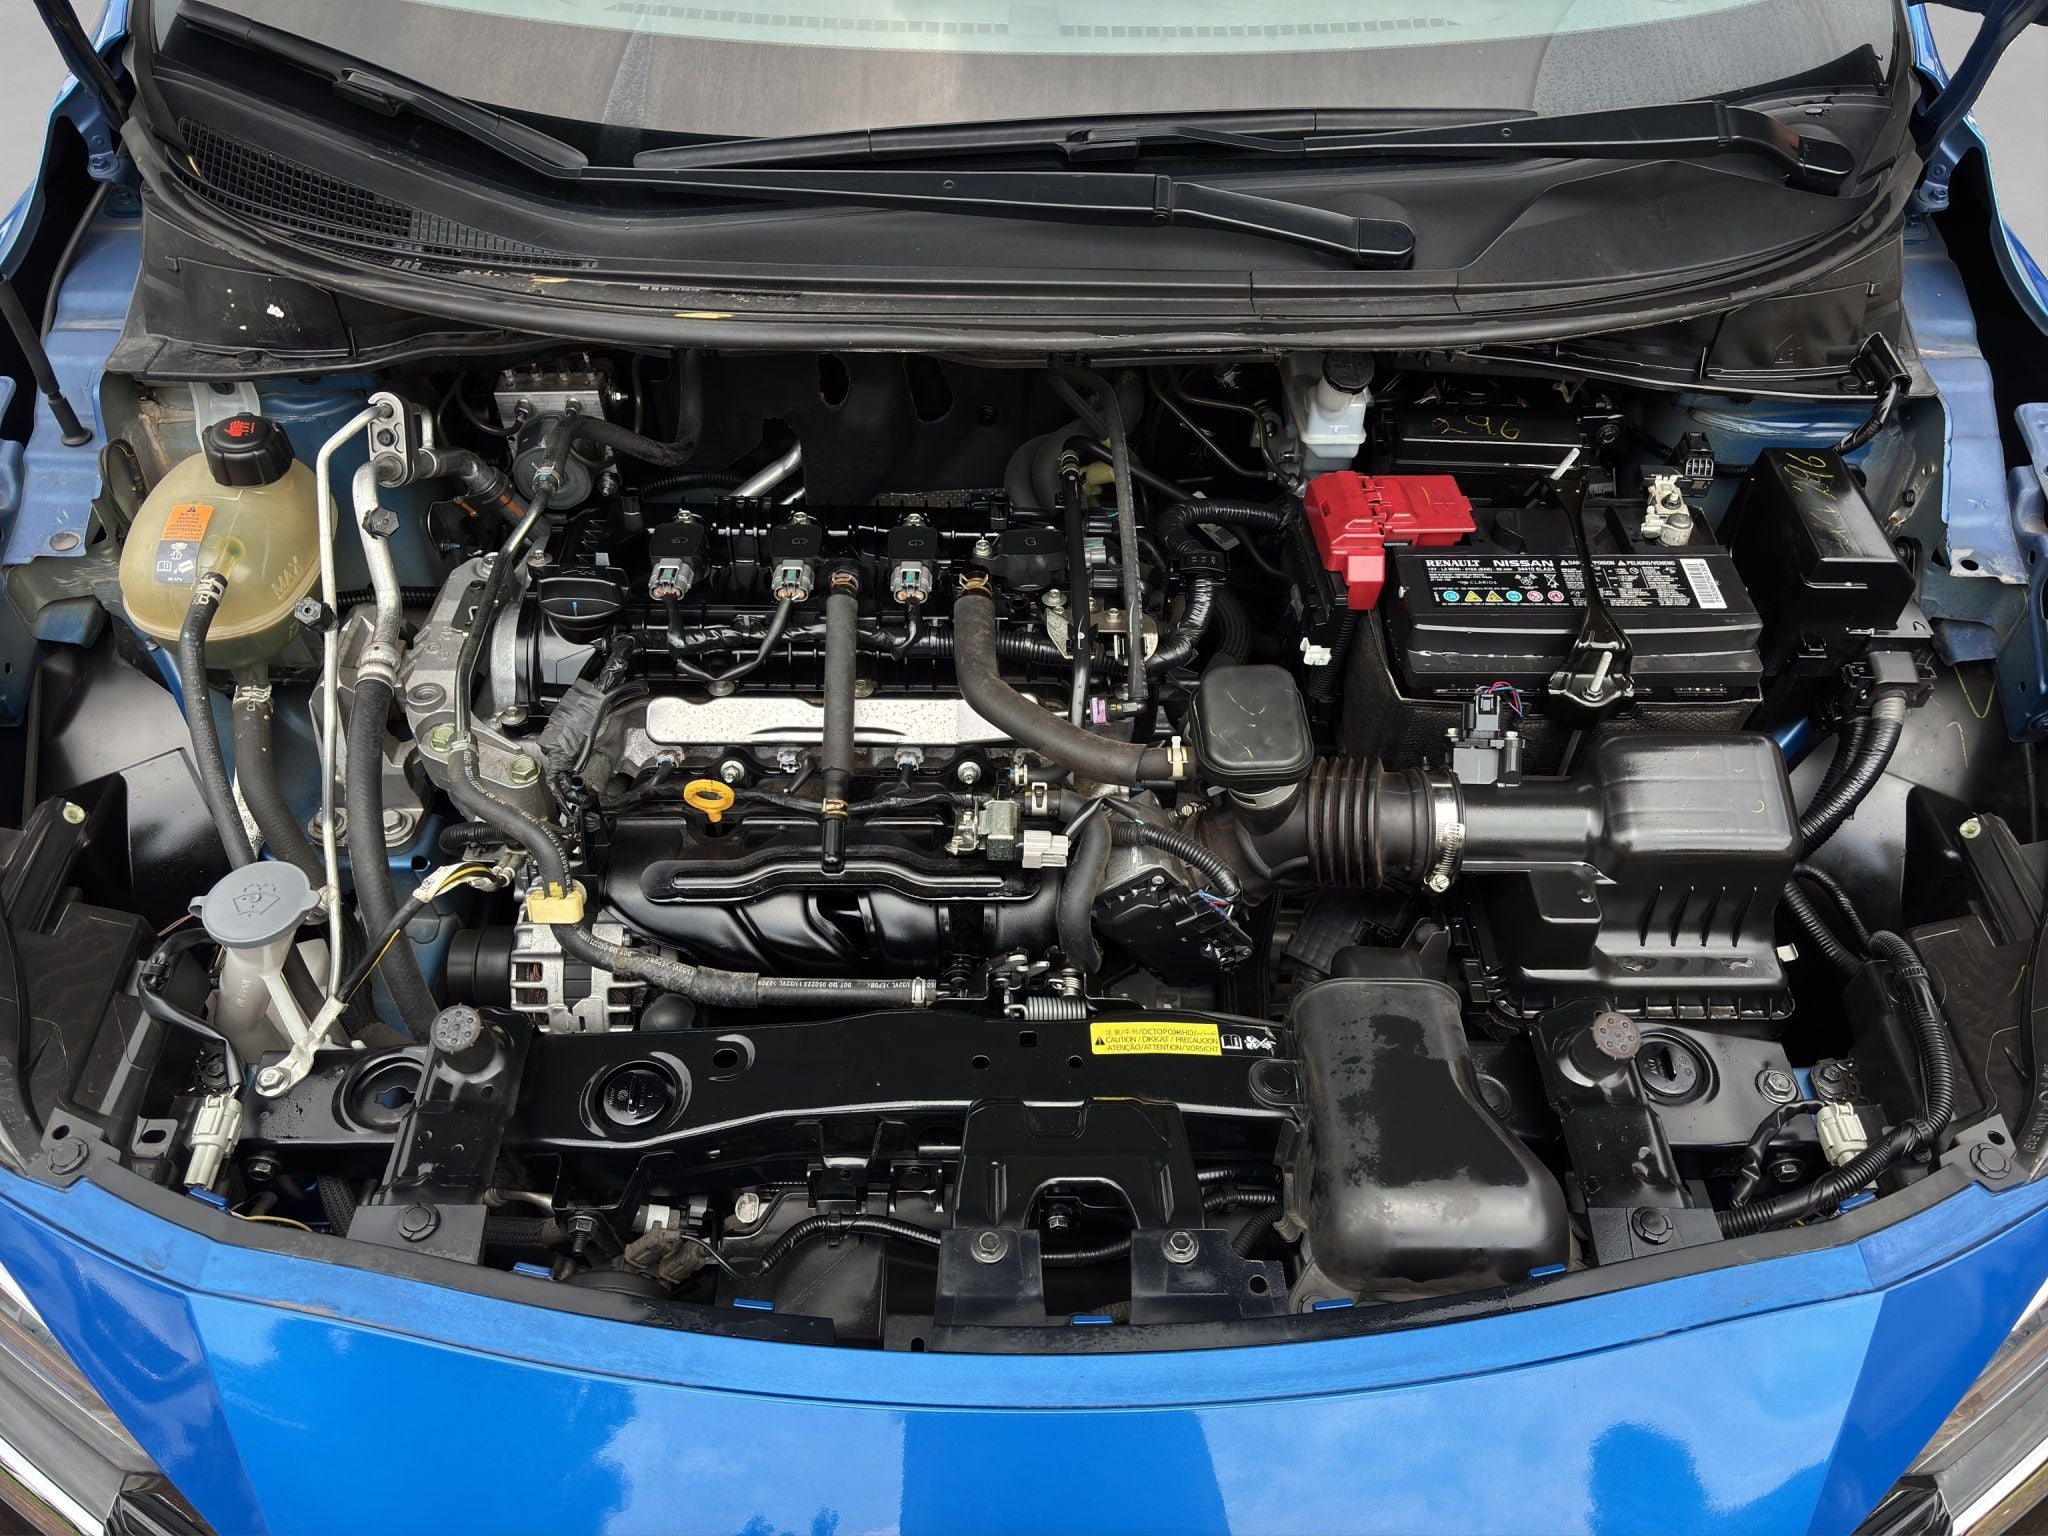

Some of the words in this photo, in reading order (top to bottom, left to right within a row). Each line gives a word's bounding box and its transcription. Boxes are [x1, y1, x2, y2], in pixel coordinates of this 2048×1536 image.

[1425, 559, 1480, 567] RENAULT
[1492, 559, 1555, 567] NISSAN
[271, 555, 300, 598] MAX
